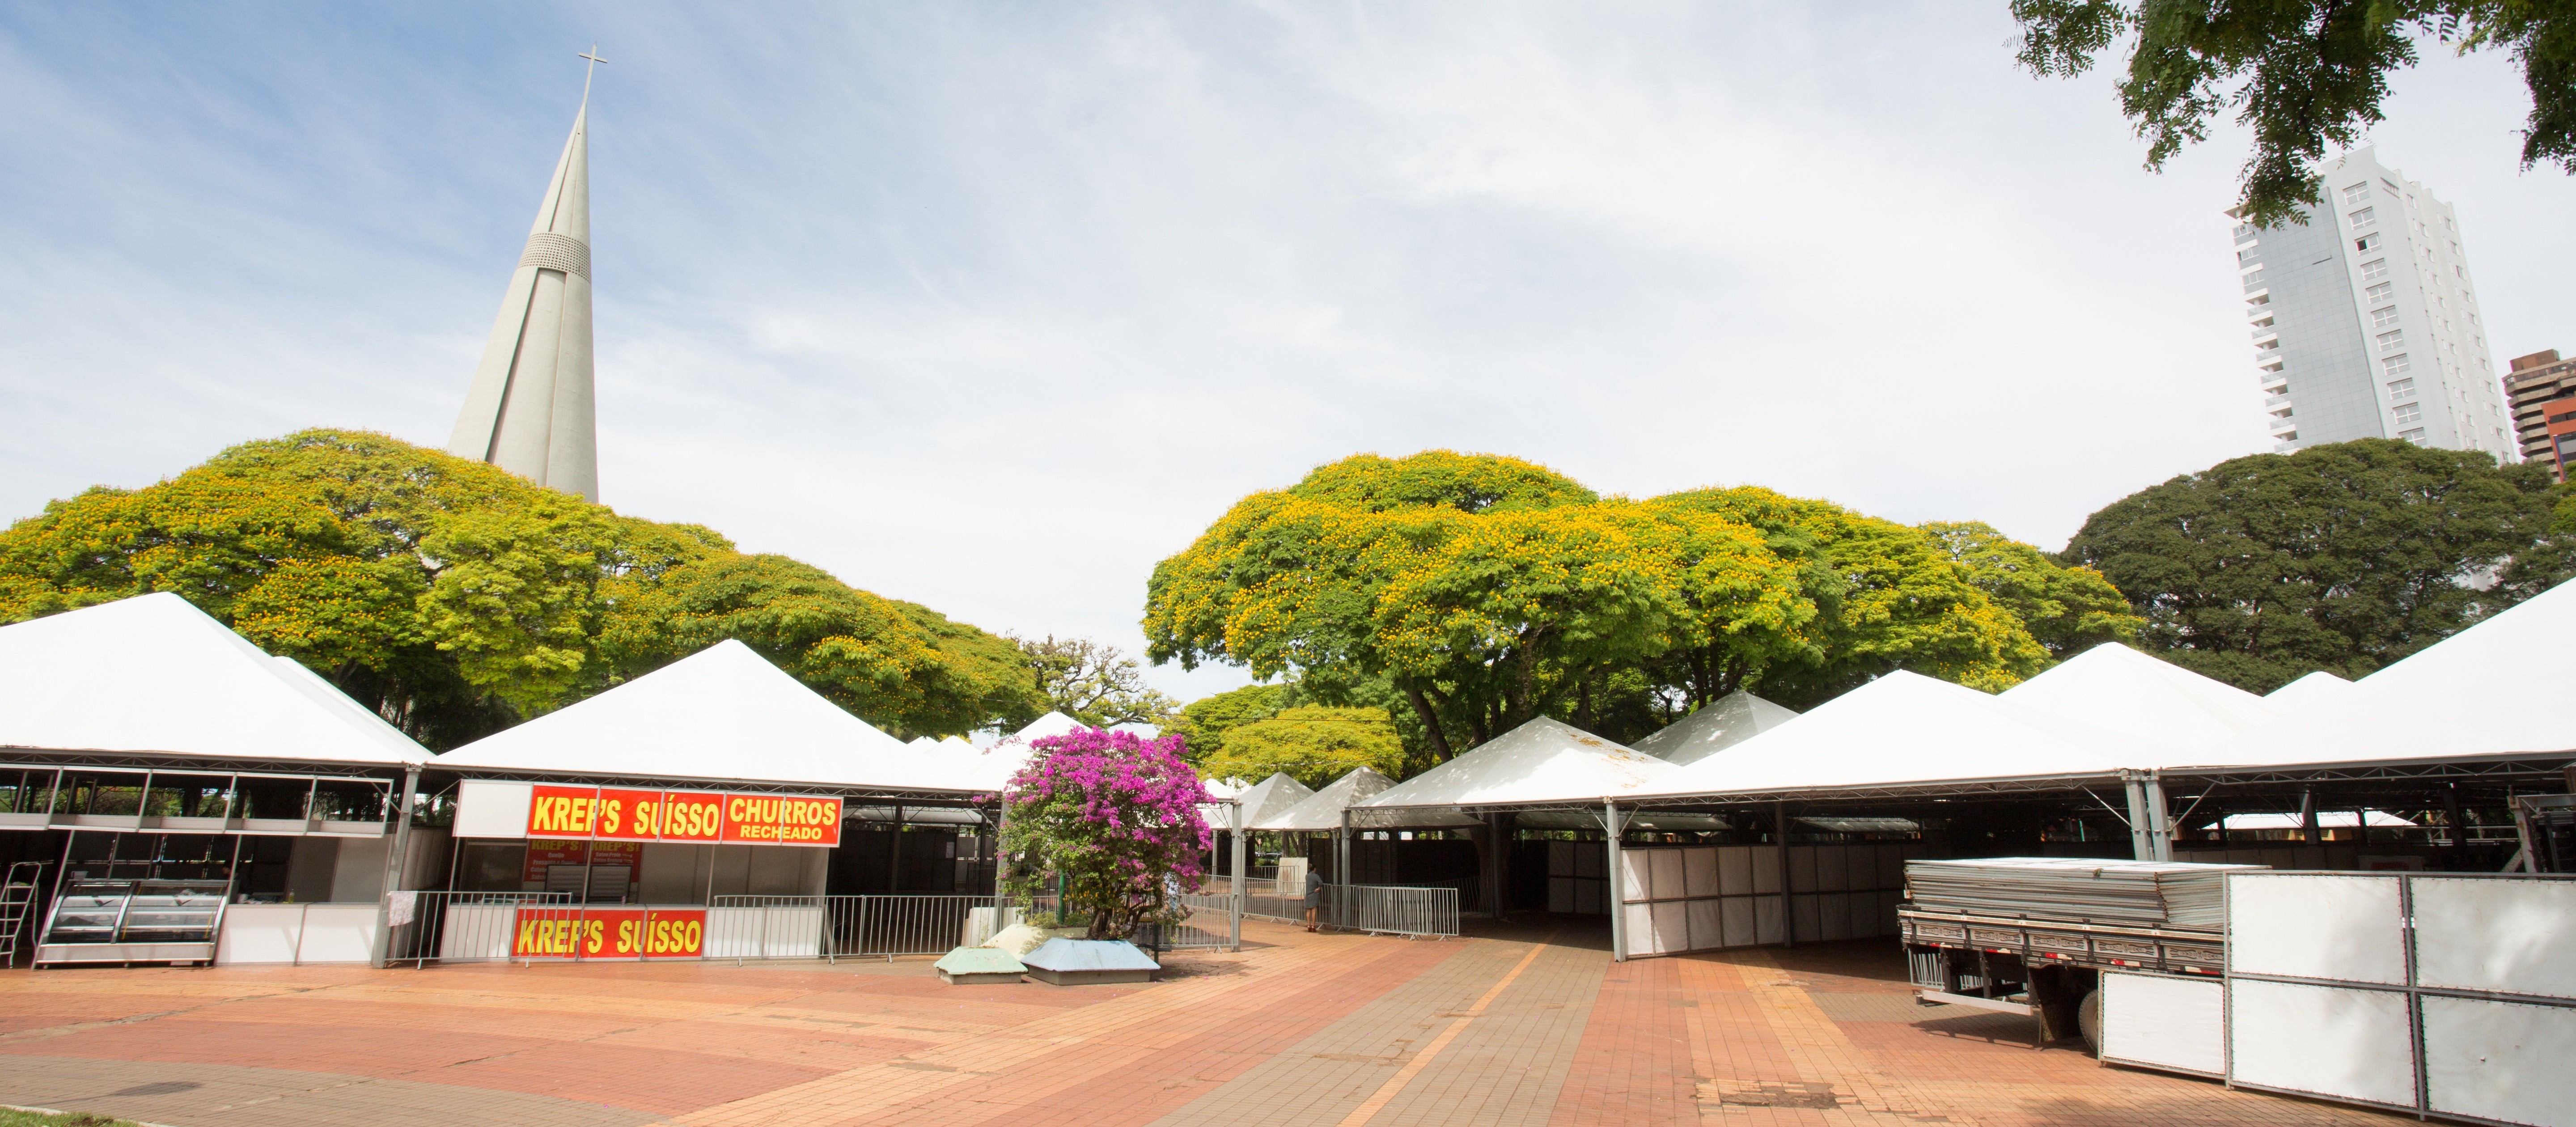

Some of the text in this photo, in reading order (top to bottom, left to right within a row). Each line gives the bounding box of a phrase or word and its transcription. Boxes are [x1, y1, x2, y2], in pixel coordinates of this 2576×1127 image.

[533, 794, 719, 837] KREP'S SUÍSSO
[729, 798, 836, 826] CHURROS
[740, 825, 822, 840] RECHEADO
[517, 912, 701, 953] KREP'S SUÍSSO
